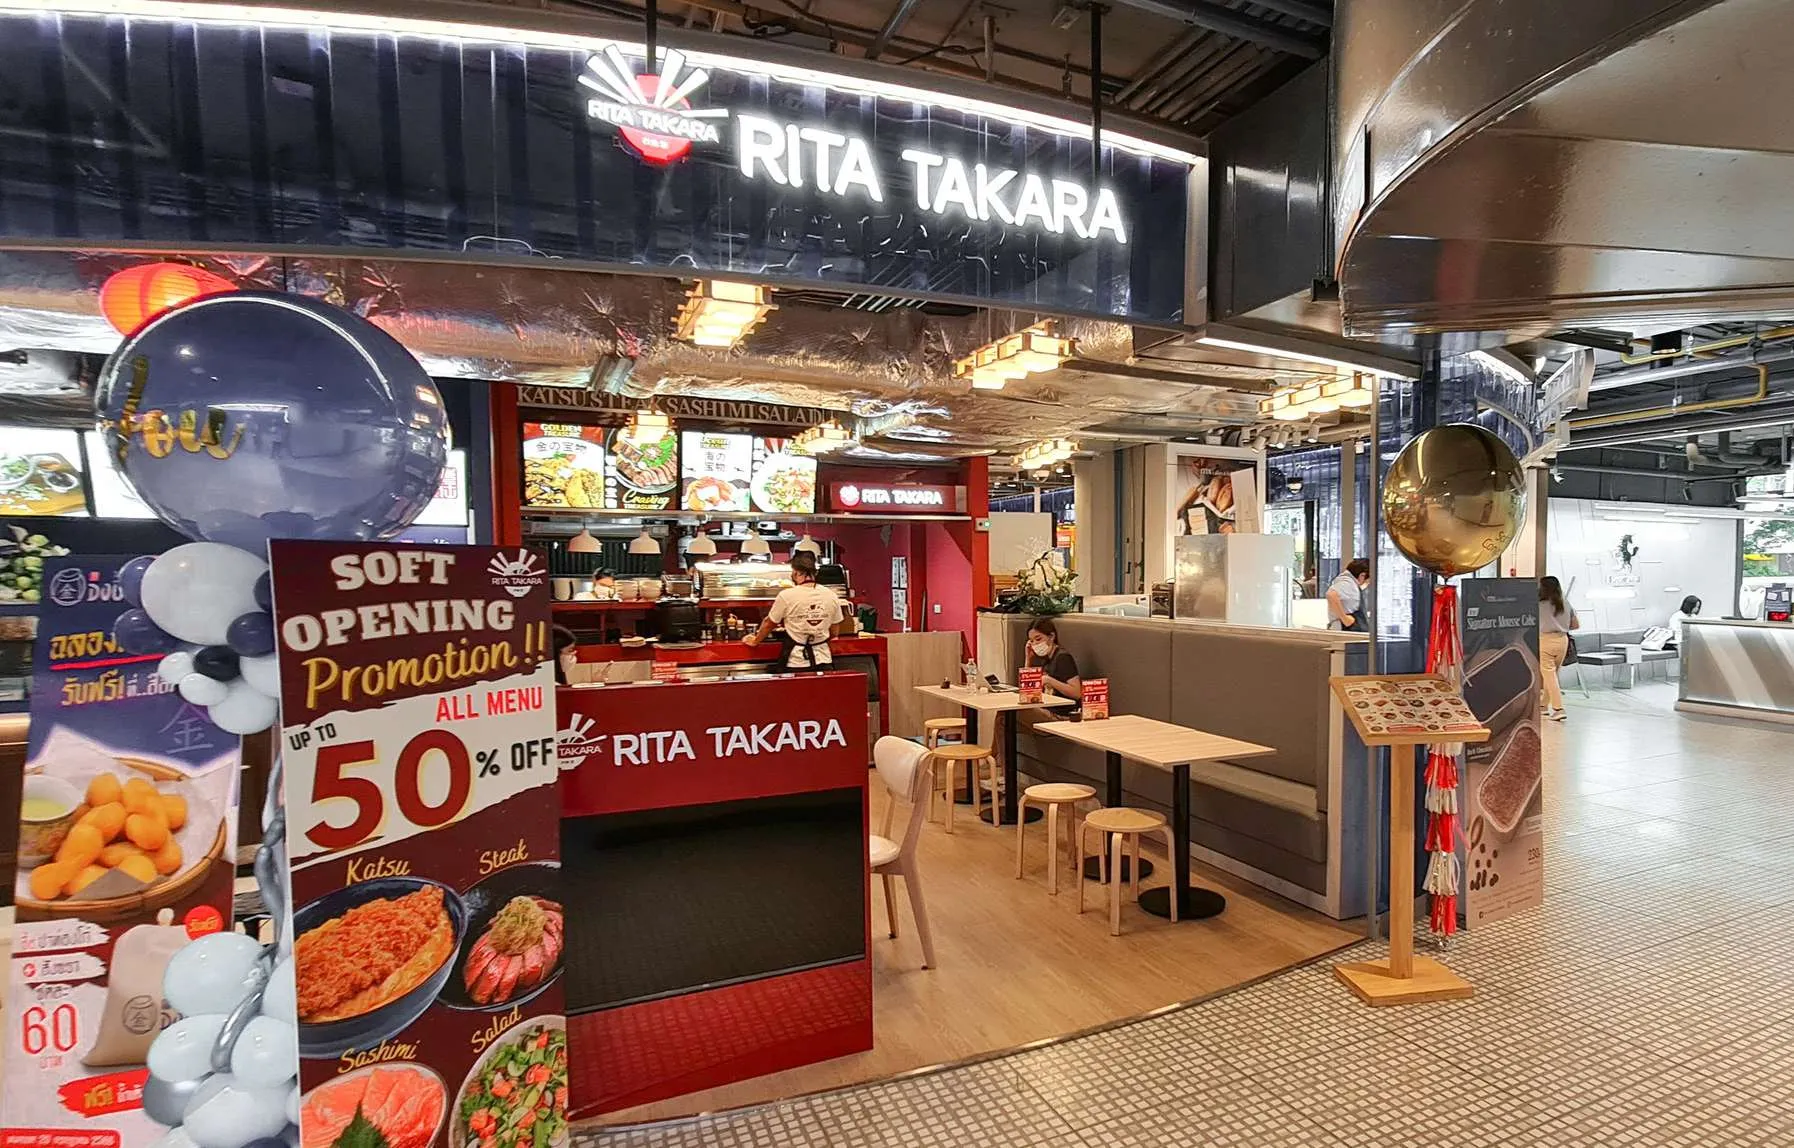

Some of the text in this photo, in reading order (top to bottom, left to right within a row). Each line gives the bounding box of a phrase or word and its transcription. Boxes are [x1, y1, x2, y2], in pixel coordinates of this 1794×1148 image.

[588, 99, 720, 144] RITA TAKARA
[737, 113, 1127, 244] RITA TAKARA
[516, 385, 824, 425] KATSU STEAK SASHIMI SALAD
[540, 423, 582, 432] GOLDEN
[622, 488, 670, 510] Craving
[861, 488, 943, 505] RITA TAKARA
[331, 551, 455, 590] SOFT
[492, 577, 543, 585] RITA TAKARA
[283, 600, 515, 651] OPENING
[1467, 617, 1497, 631] Signature
[1498, 615, 1520, 628] Mousse
[302, 637, 517, 708] Promotion
[435, 686, 543, 722] ALL MENU
[289, 722, 337, 751] UP TO
[510, 738, 554, 771] OFF
[560, 744, 602, 757] TAKARA
[613, 718, 847, 767] RITA TAKARA
[346, 855, 411, 886] Katsu
[478, 838, 529, 875] Steak
[22, 1003, 78, 1055] 60
[471, 1005, 521, 1053] Salad
[337, 1040, 421, 1074] Sashimi
